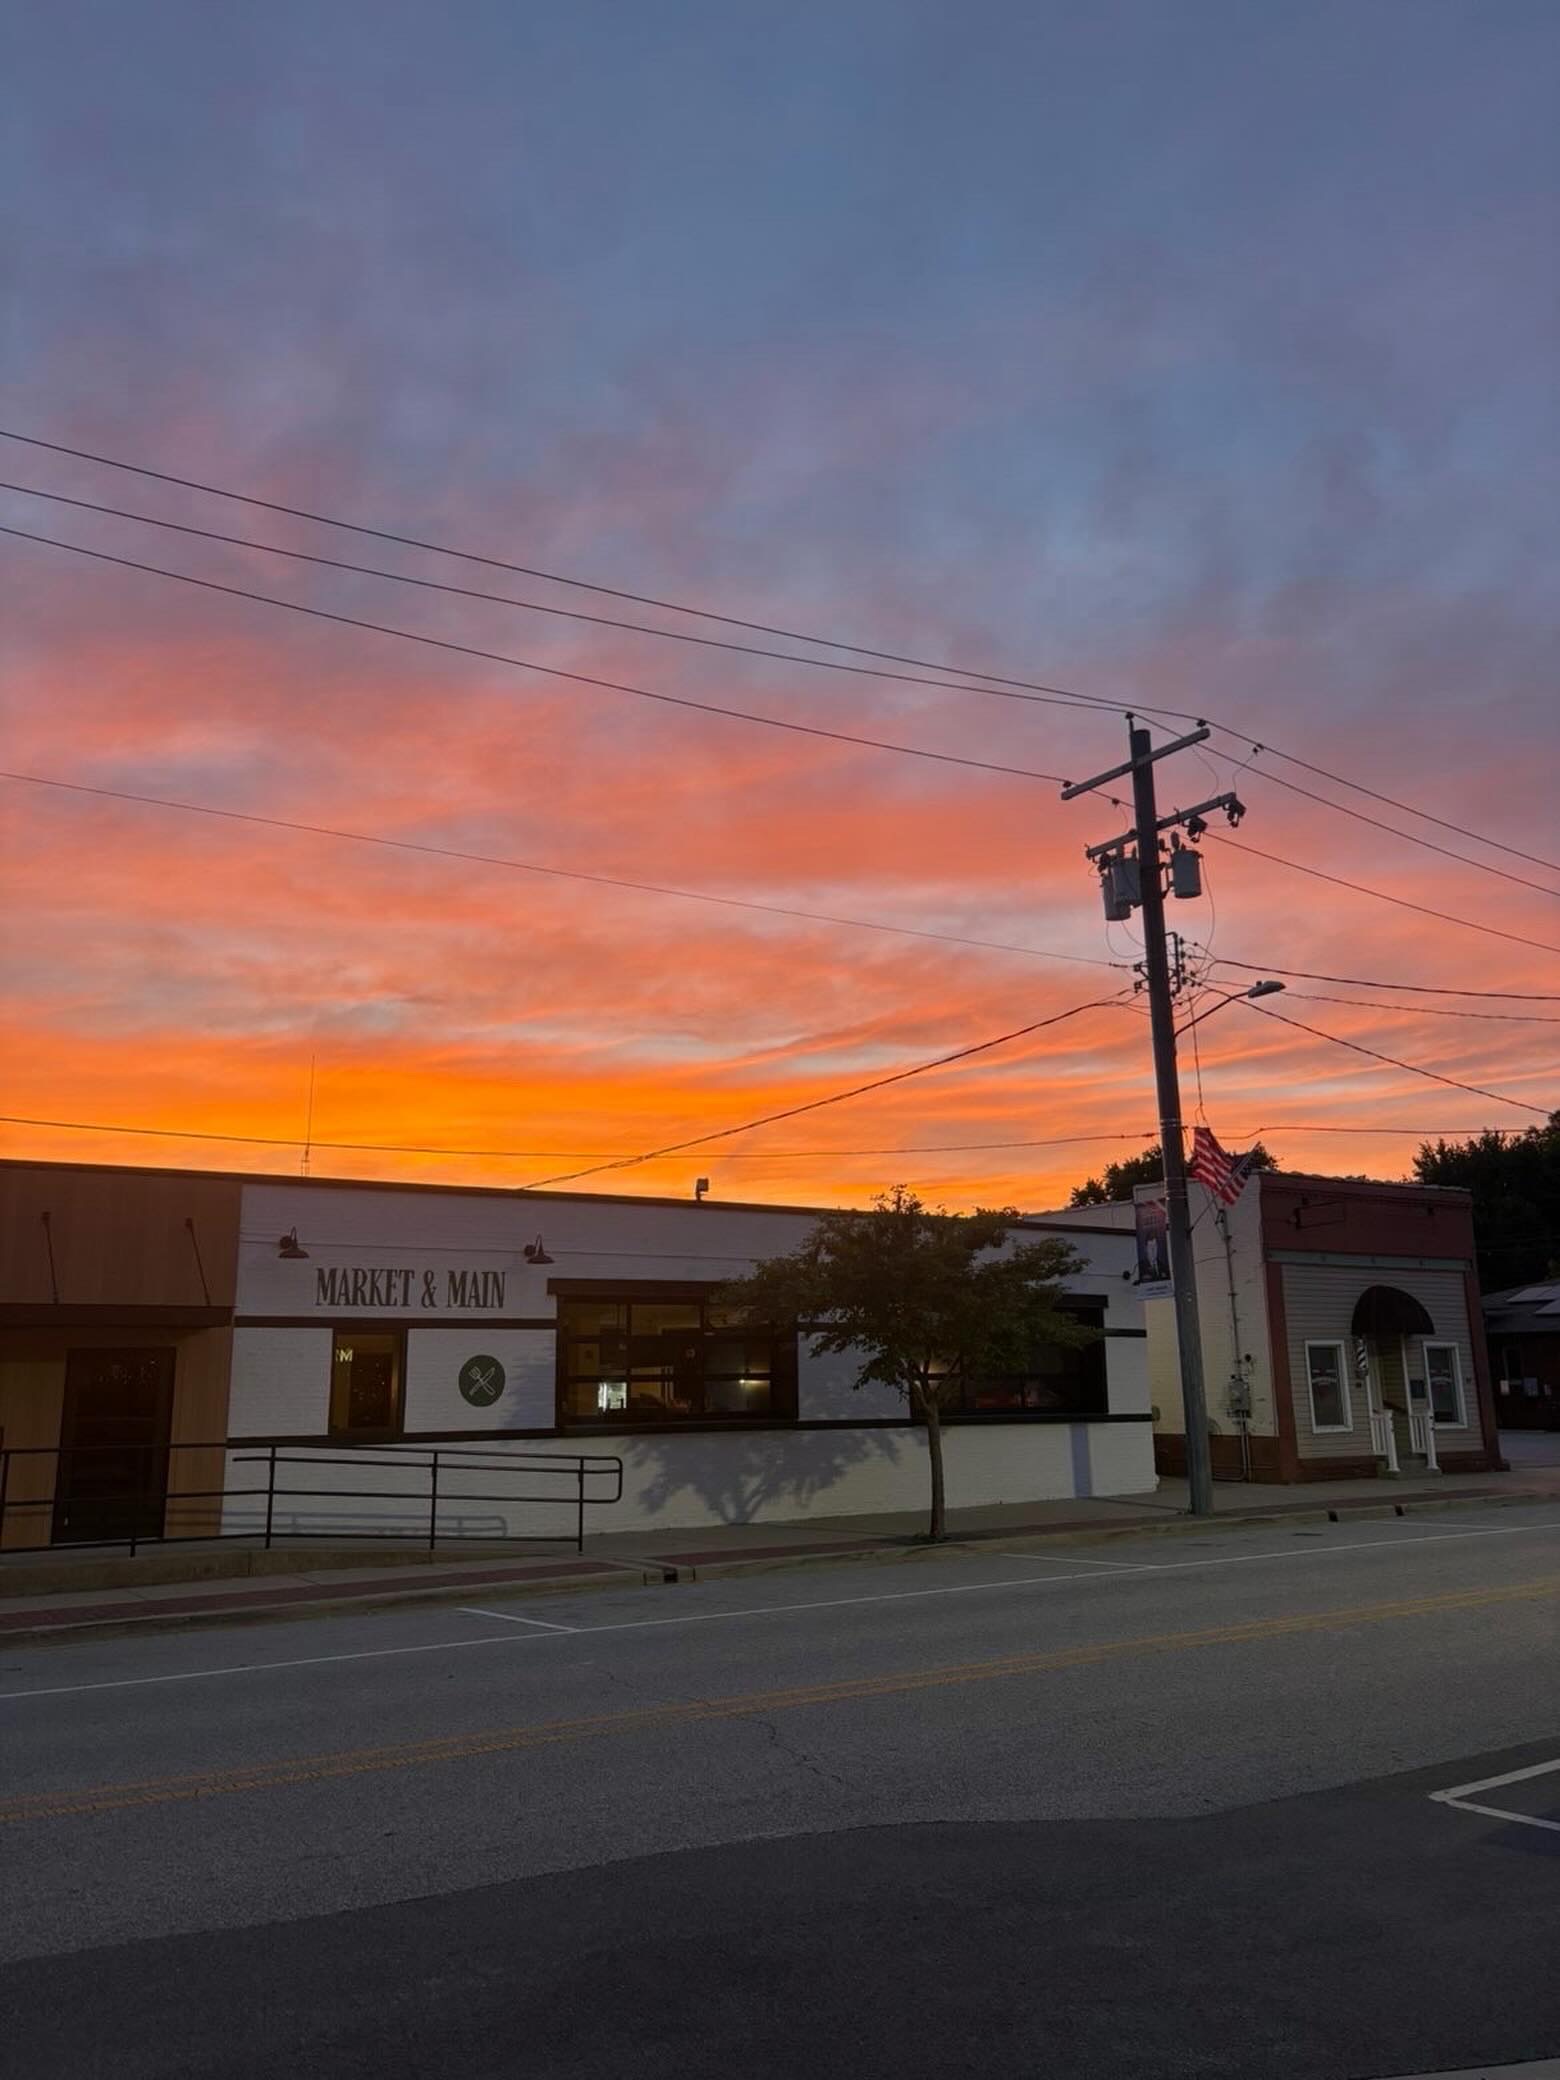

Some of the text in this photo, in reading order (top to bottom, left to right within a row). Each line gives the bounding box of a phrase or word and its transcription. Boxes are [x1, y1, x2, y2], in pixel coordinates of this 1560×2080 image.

[316, 1267, 506, 1309] MARKET & MAIN
